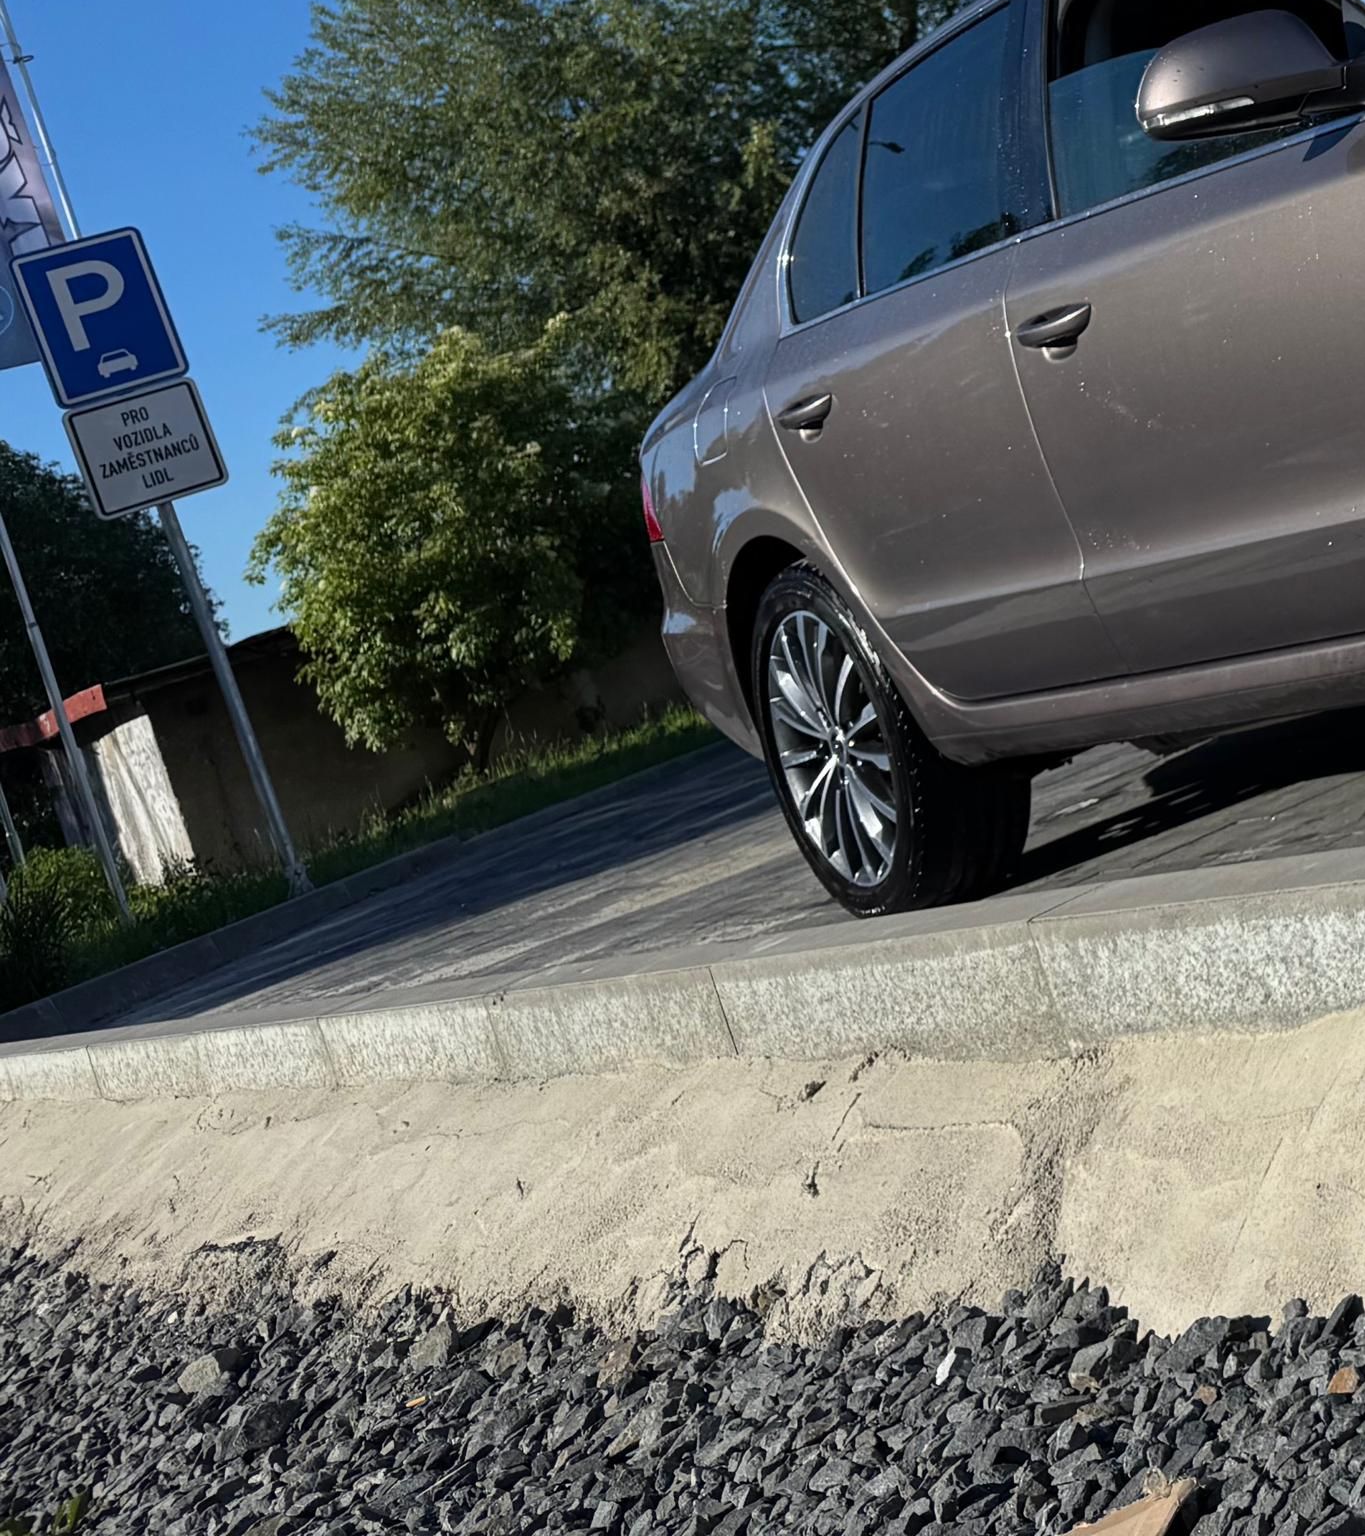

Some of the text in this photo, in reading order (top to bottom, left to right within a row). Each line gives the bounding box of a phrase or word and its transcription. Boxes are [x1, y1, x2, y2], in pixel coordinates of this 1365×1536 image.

[45, 260, 125, 351] P
[120, 406, 149, 427] PRO
[113, 422, 173, 452] VOZIDLA
[99, 432, 200, 480] ZAMĚSTNANCŮ
[141, 467, 175, 489] LIDL
